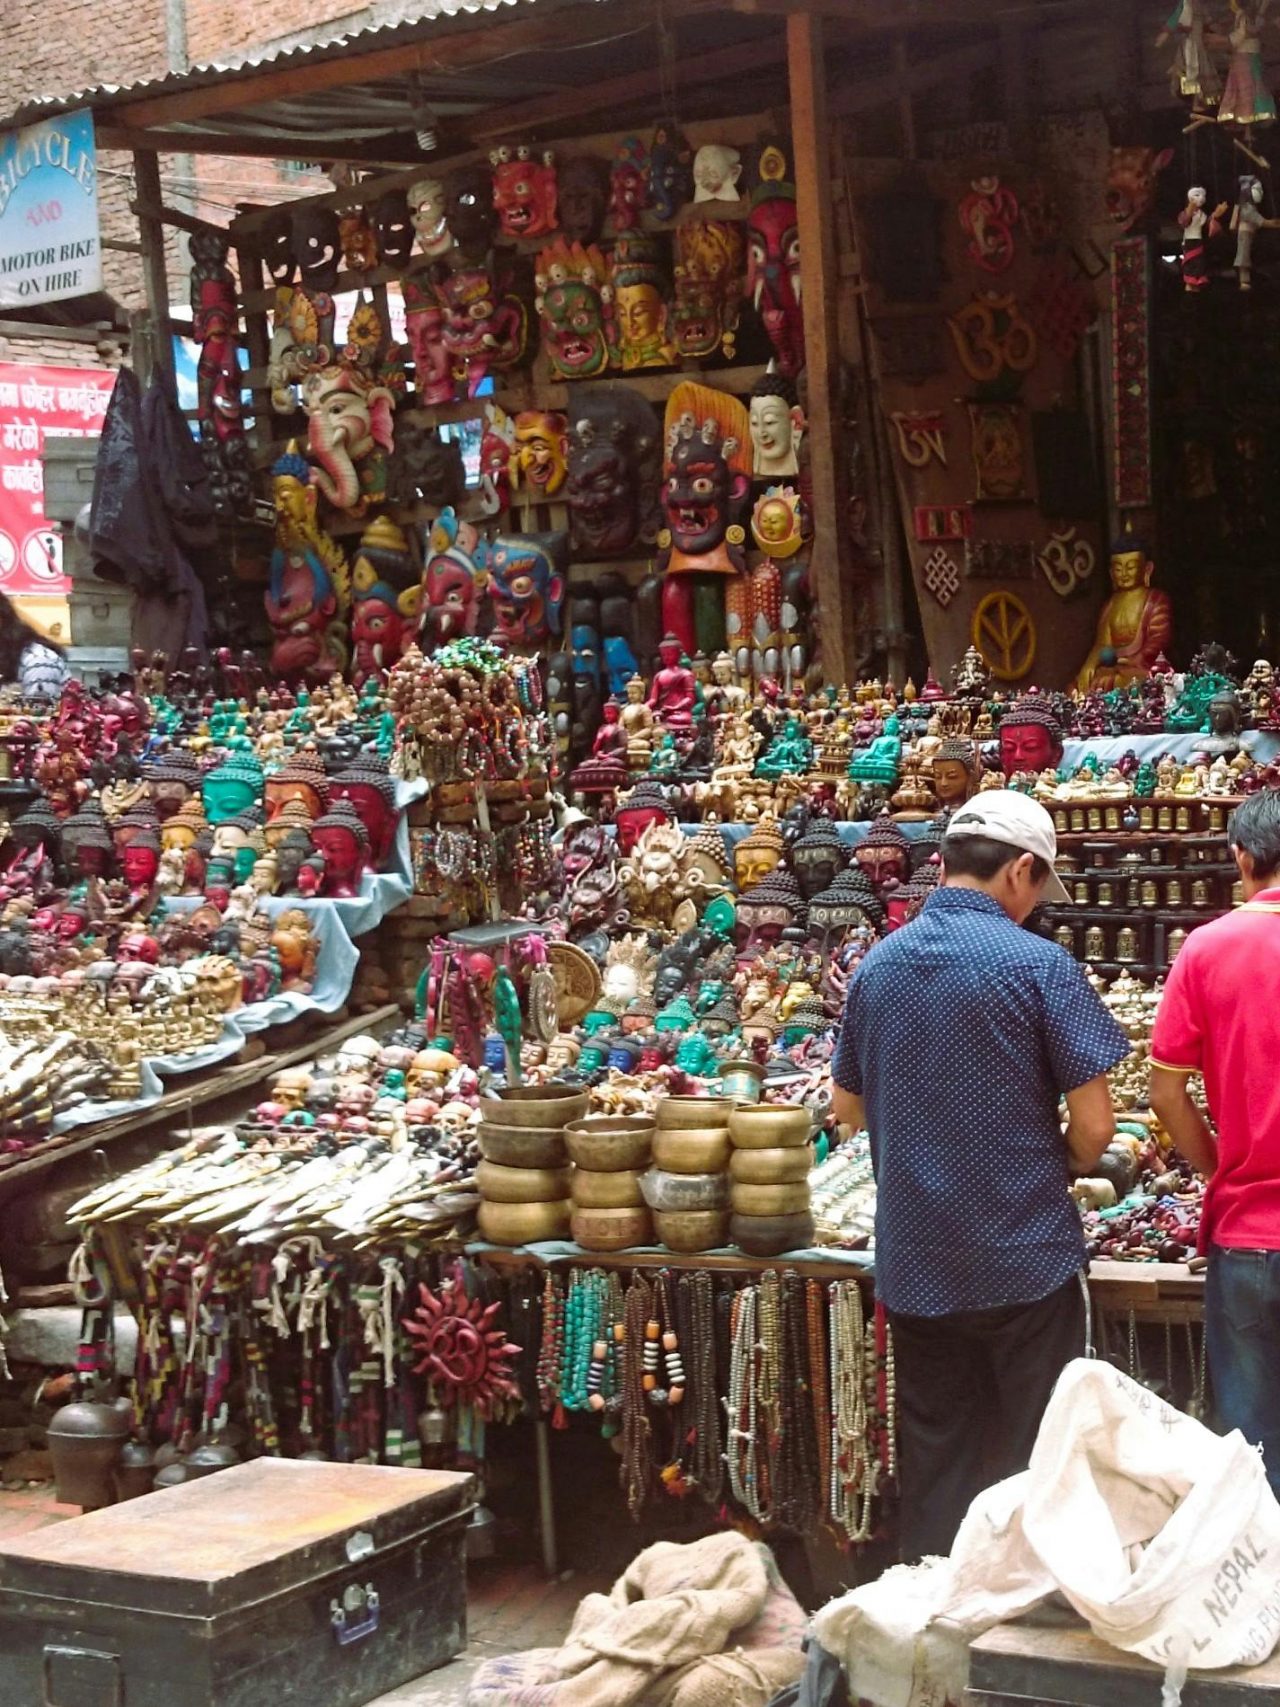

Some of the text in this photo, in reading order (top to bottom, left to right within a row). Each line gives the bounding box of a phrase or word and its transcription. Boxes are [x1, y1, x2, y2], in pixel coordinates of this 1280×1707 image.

[26, 200, 62, 227] AND
[0, 238, 95, 274] MOTOR BIKE
[18, 269, 82, 296] ON HIRE
[1203, 1534, 1268, 1628] NEPAL
